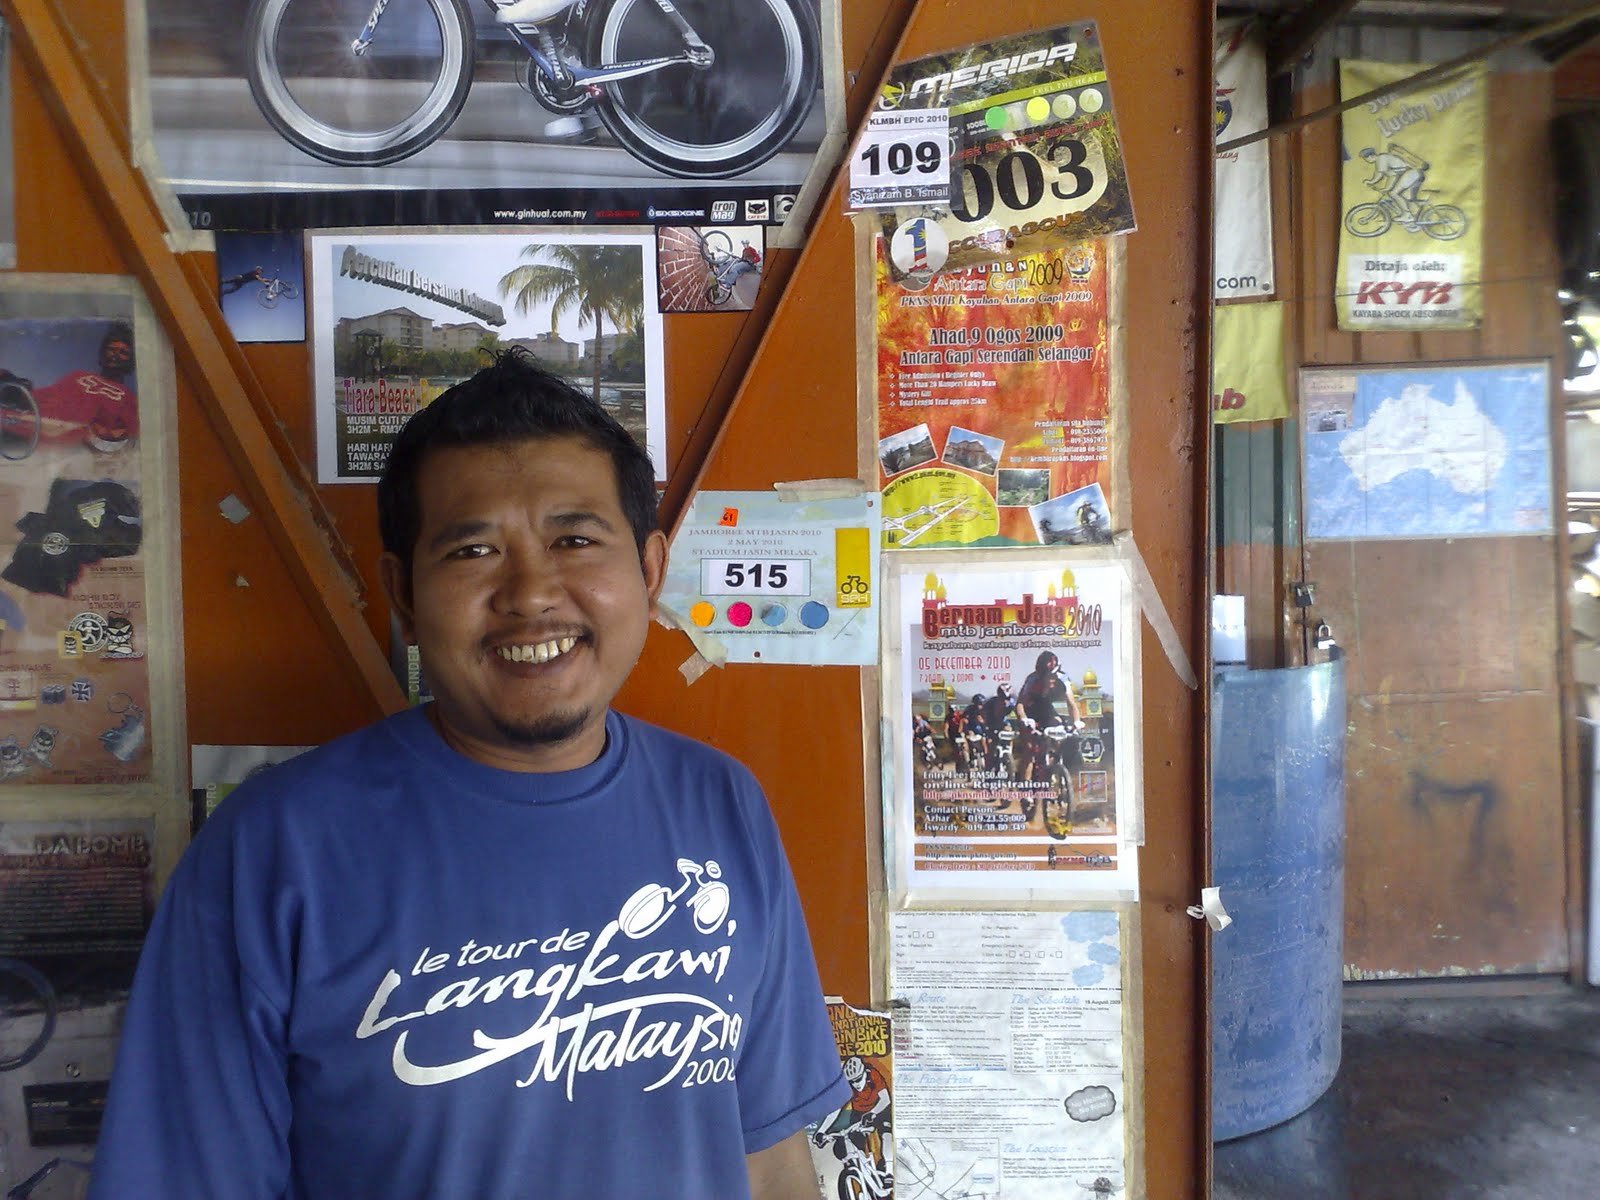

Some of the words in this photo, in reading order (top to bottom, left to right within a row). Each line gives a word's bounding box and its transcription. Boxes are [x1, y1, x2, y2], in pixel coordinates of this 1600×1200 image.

[909, 42, 1078, 99] MERIDA
[870, 115, 902, 127] KLMBH
[904, 114, 925, 125] EPIC
[926, 113, 948, 124] 2010
[1376, 103, 1431, 138] Lucky
[862, 142, 942, 176] 109
[934, 276, 987, 291] Antara
[991, 273, 1029, 293] Gapi
[1029, 258, 1064, 286] 2009
[959, 295, 999, 306] Kayuhan
[1002, 294, 1034, 304] Antara
[1038, 293, 1062, 305] Gapi
[1065, 292, 1092, 302] 2009
[1356, 281, 1453, 304] KYB
[1352, 310, 1382, 318] KAYABA
[1384, 309, 1410, 317] SHOCK
[986, 327, 1021, 345] Ogos
[1025, 325, 1063, 341] 2009
[900, 351, 941, 365] Antara
[946, 350, 973, 365] Gapi
[978, 348, 1034, 363] Serendah
[1038, 345, 1093, 363] Selangor
[343, 377, 376, 414] Tiara
[379, 377, 417, 414] Beach
[347, 416, 376, 425] MUSIM
[378, 416, 399, 425] CUTI
[347, 425, 371, 434] 3H2M
[347, 443, 369, 452] HARI
[347, 453, 390, 461] TAWARA
[347, 461, 371, 470] 3H2M
[725, 563, 788, 589] 515
[924, 606, 1004, 639] Bernam
[1016, 594, 1065, 625] Jaya
[1068, 604, 1102, 636] 2010
[940, 625, 976, 638] mtb
[979, 625, 1066, 638] jamboree
[918, 657, 932, 670] 05
[935, 657, 983, 670] DECEMBER
[987, 656, 1011, 669] 2010
[923, 771, 945, 781] Entry
[924, 805, 958, 814] Contact
[924, 814, 950, 823] Azhar
[412, 947, 450, 976] le
[457, 937, 538, 967] tour
[541, 928, 592, 955] de
[356, 920, 738, 1040] Langkawi
[516, 1000, 743, 1102] Malaysia
[856, 1040, 887, 1056] 2010
